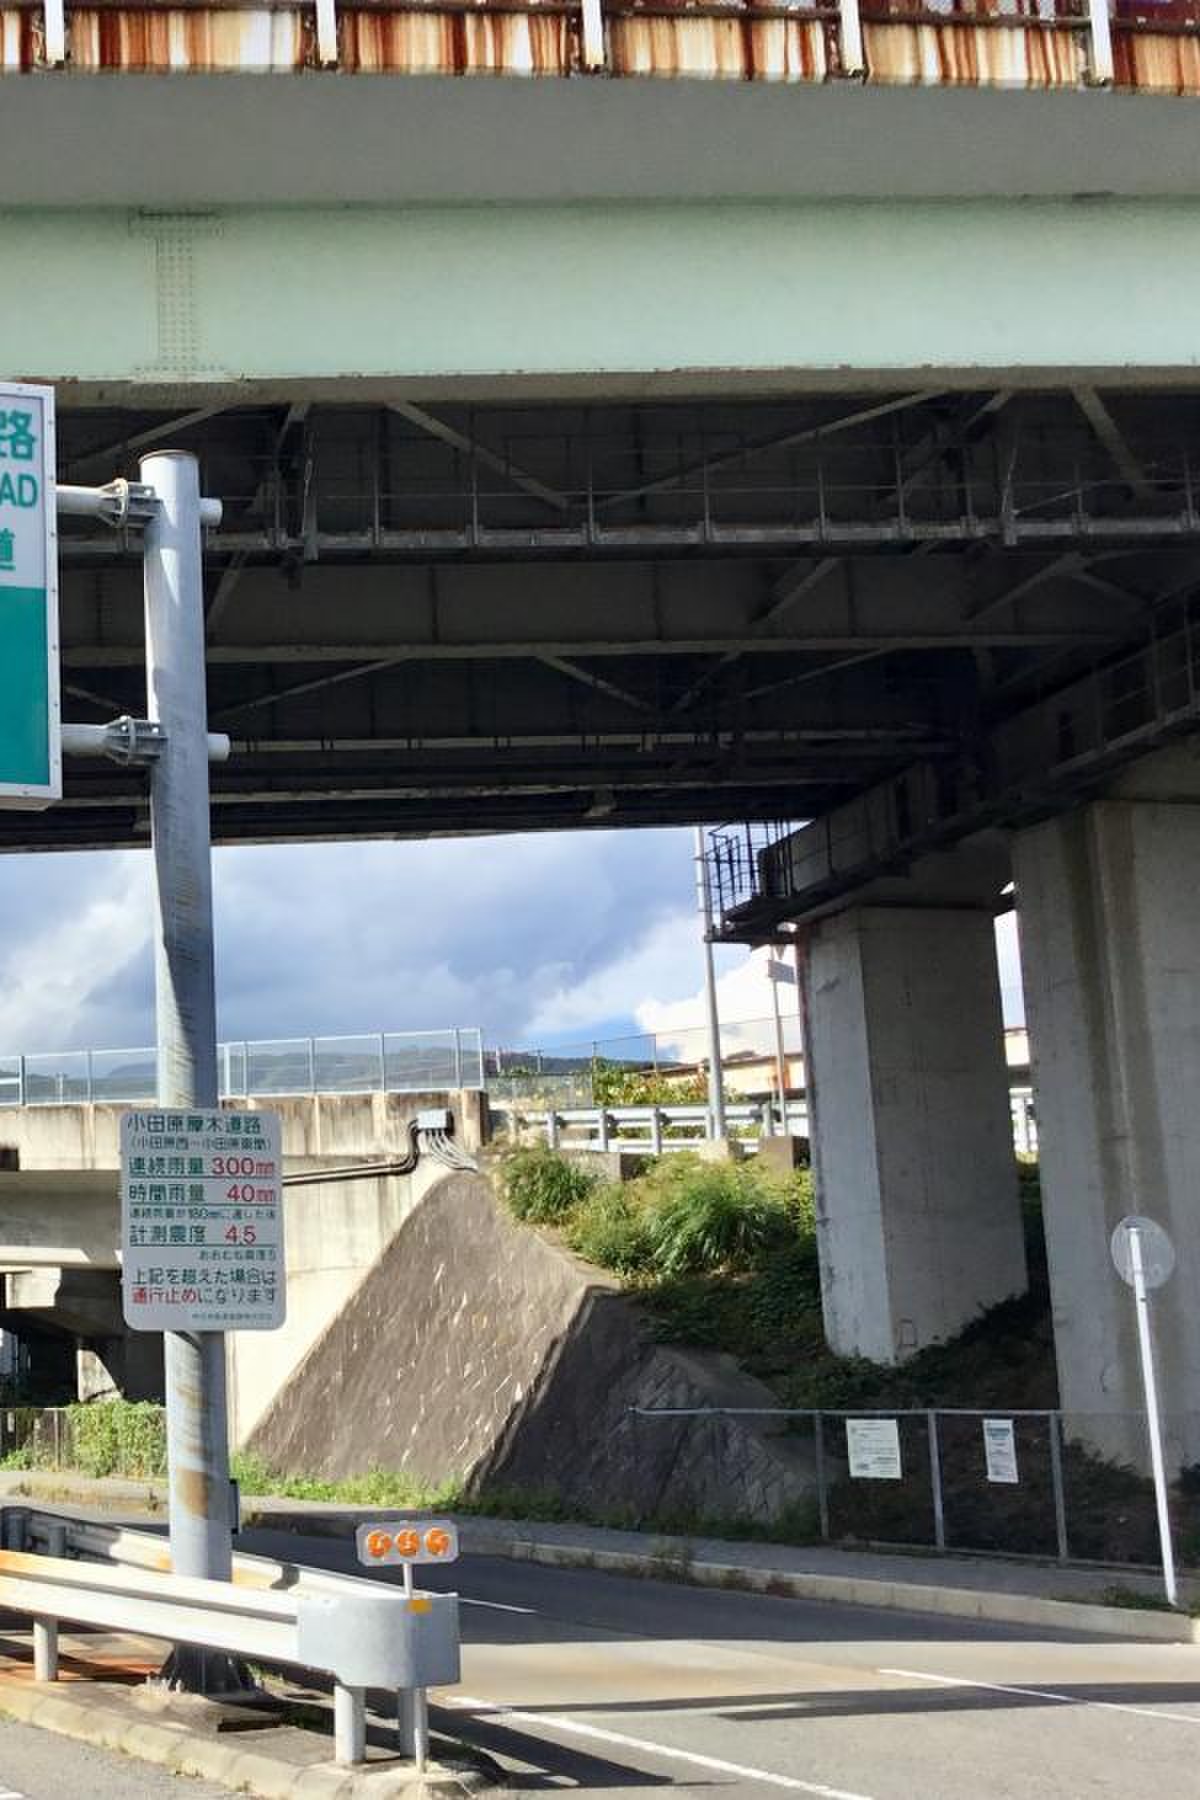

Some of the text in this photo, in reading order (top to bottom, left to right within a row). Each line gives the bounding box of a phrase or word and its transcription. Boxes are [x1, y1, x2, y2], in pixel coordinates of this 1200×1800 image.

[127, 1115, 261, 1134] 小田原厚木道路
[129, 1156, 204, 1175] 連続雨量
[129, 1183, 204, 1202] 時間雨量
[129, 1225, 206, 1244] 計測震度
[132, 1267, 276, 1285] 上記を超えた場合は
[132, 1288, 275, 1304] 通行止めになります
